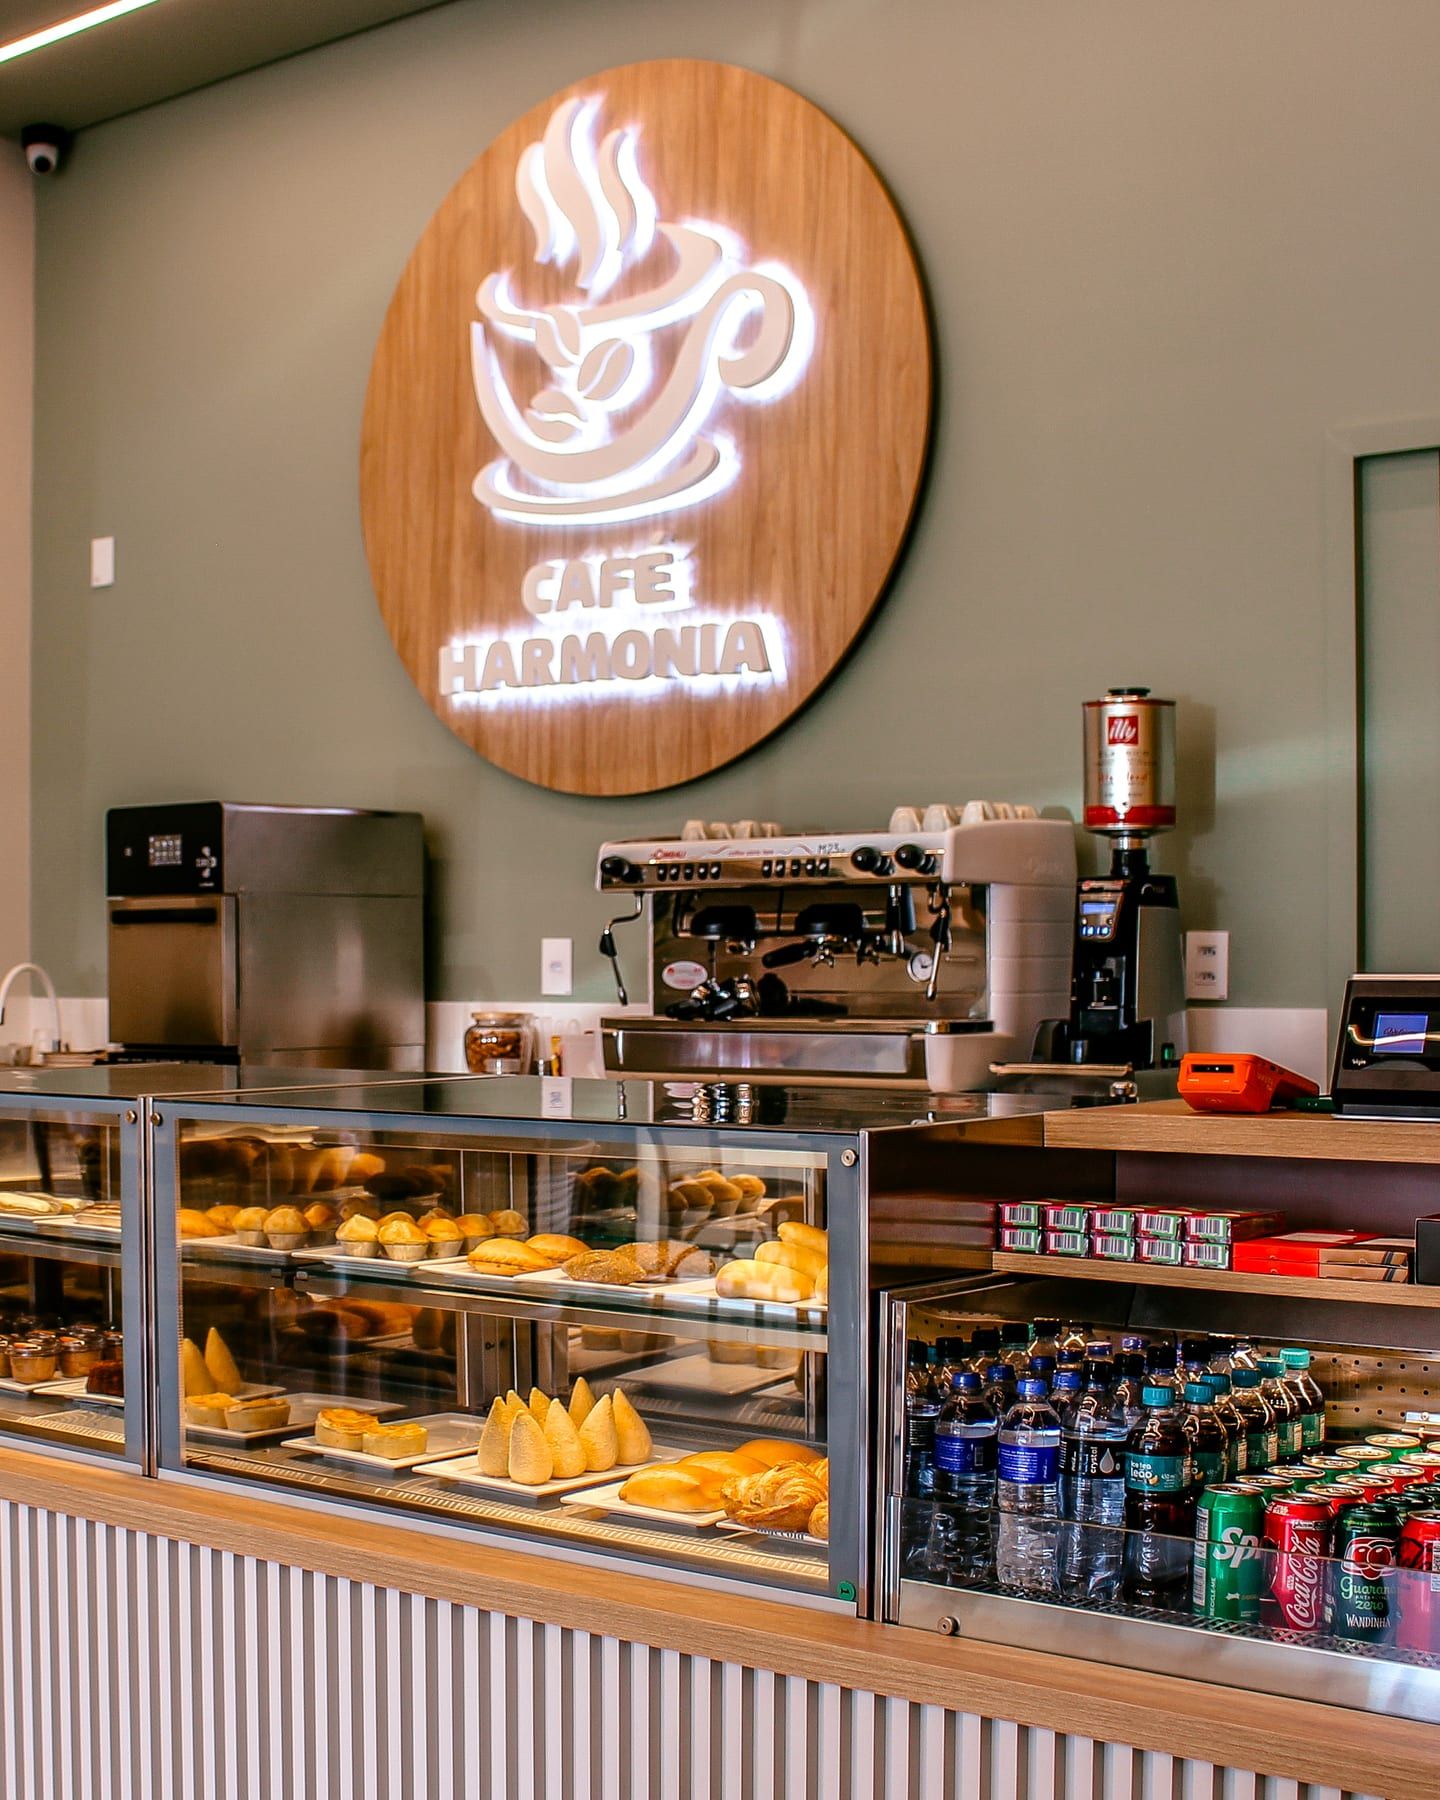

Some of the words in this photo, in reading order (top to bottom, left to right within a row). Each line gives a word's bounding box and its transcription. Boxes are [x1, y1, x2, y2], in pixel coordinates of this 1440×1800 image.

[521, 531, 676, 614] CAFÉ
[438, 621, 772, 696] HARMONIA
[1109, 719, 1137, 742] illy
[1090, 1446, 1099, 1474] crystal
[1286, 1529, 1320, 1628] Coca-Cola
[1355, 1600, 1384, 1610] zero
[1345, 1613, 1392, 1630] WANDINHA
